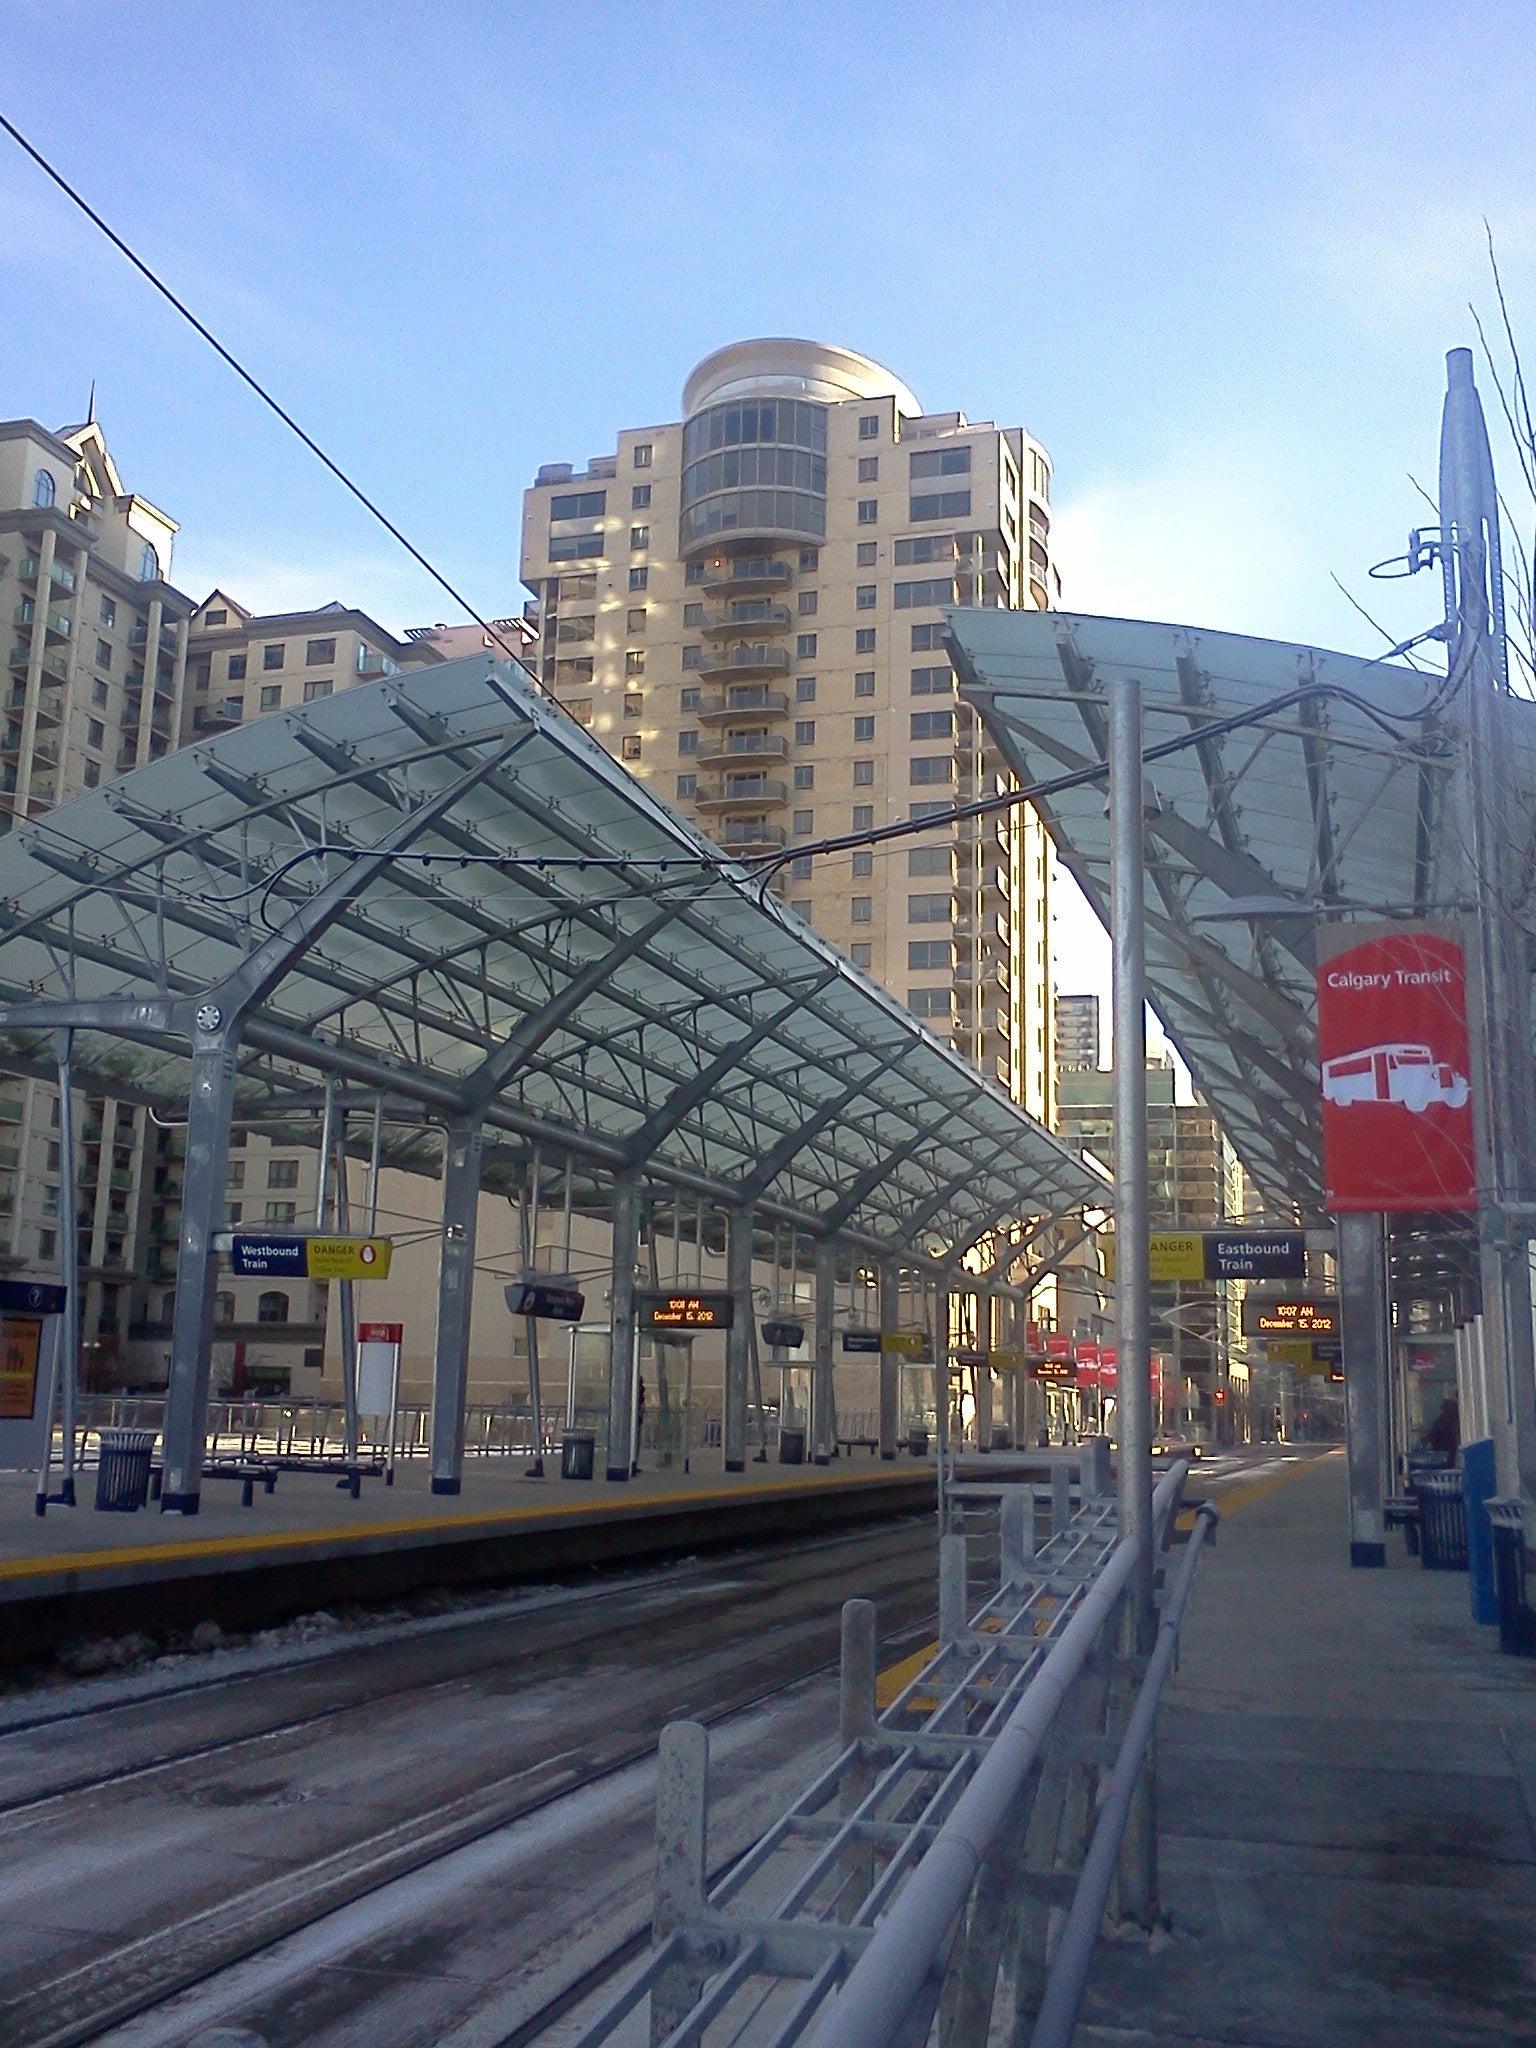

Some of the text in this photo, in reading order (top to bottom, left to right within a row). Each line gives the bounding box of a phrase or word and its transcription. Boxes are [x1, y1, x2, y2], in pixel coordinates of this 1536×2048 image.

[1327, 968, 1451, 989] Calgary Transit
[240, 1245, 299, 1256] Westbound
[314, 1245, 356, 1255] DANGER
[1150, 1241, 1193, 1252] ANGER
[1217, 1242, 1290, 1255] Eastbound
[242, 1258, 268, 1269] Train
[1219, 1259, 1254, 1271] Train
[688, 1299, 700, 1309] AM
[654, 1311, 682, 1320] December
[697, 1311, 714, 1321] 2012
[1276, 1305, 1314, 1317] 10:07 AM
[1259, 1317, 1295, 1329] December
[1312, 1318, 1332, 1330] 2012
